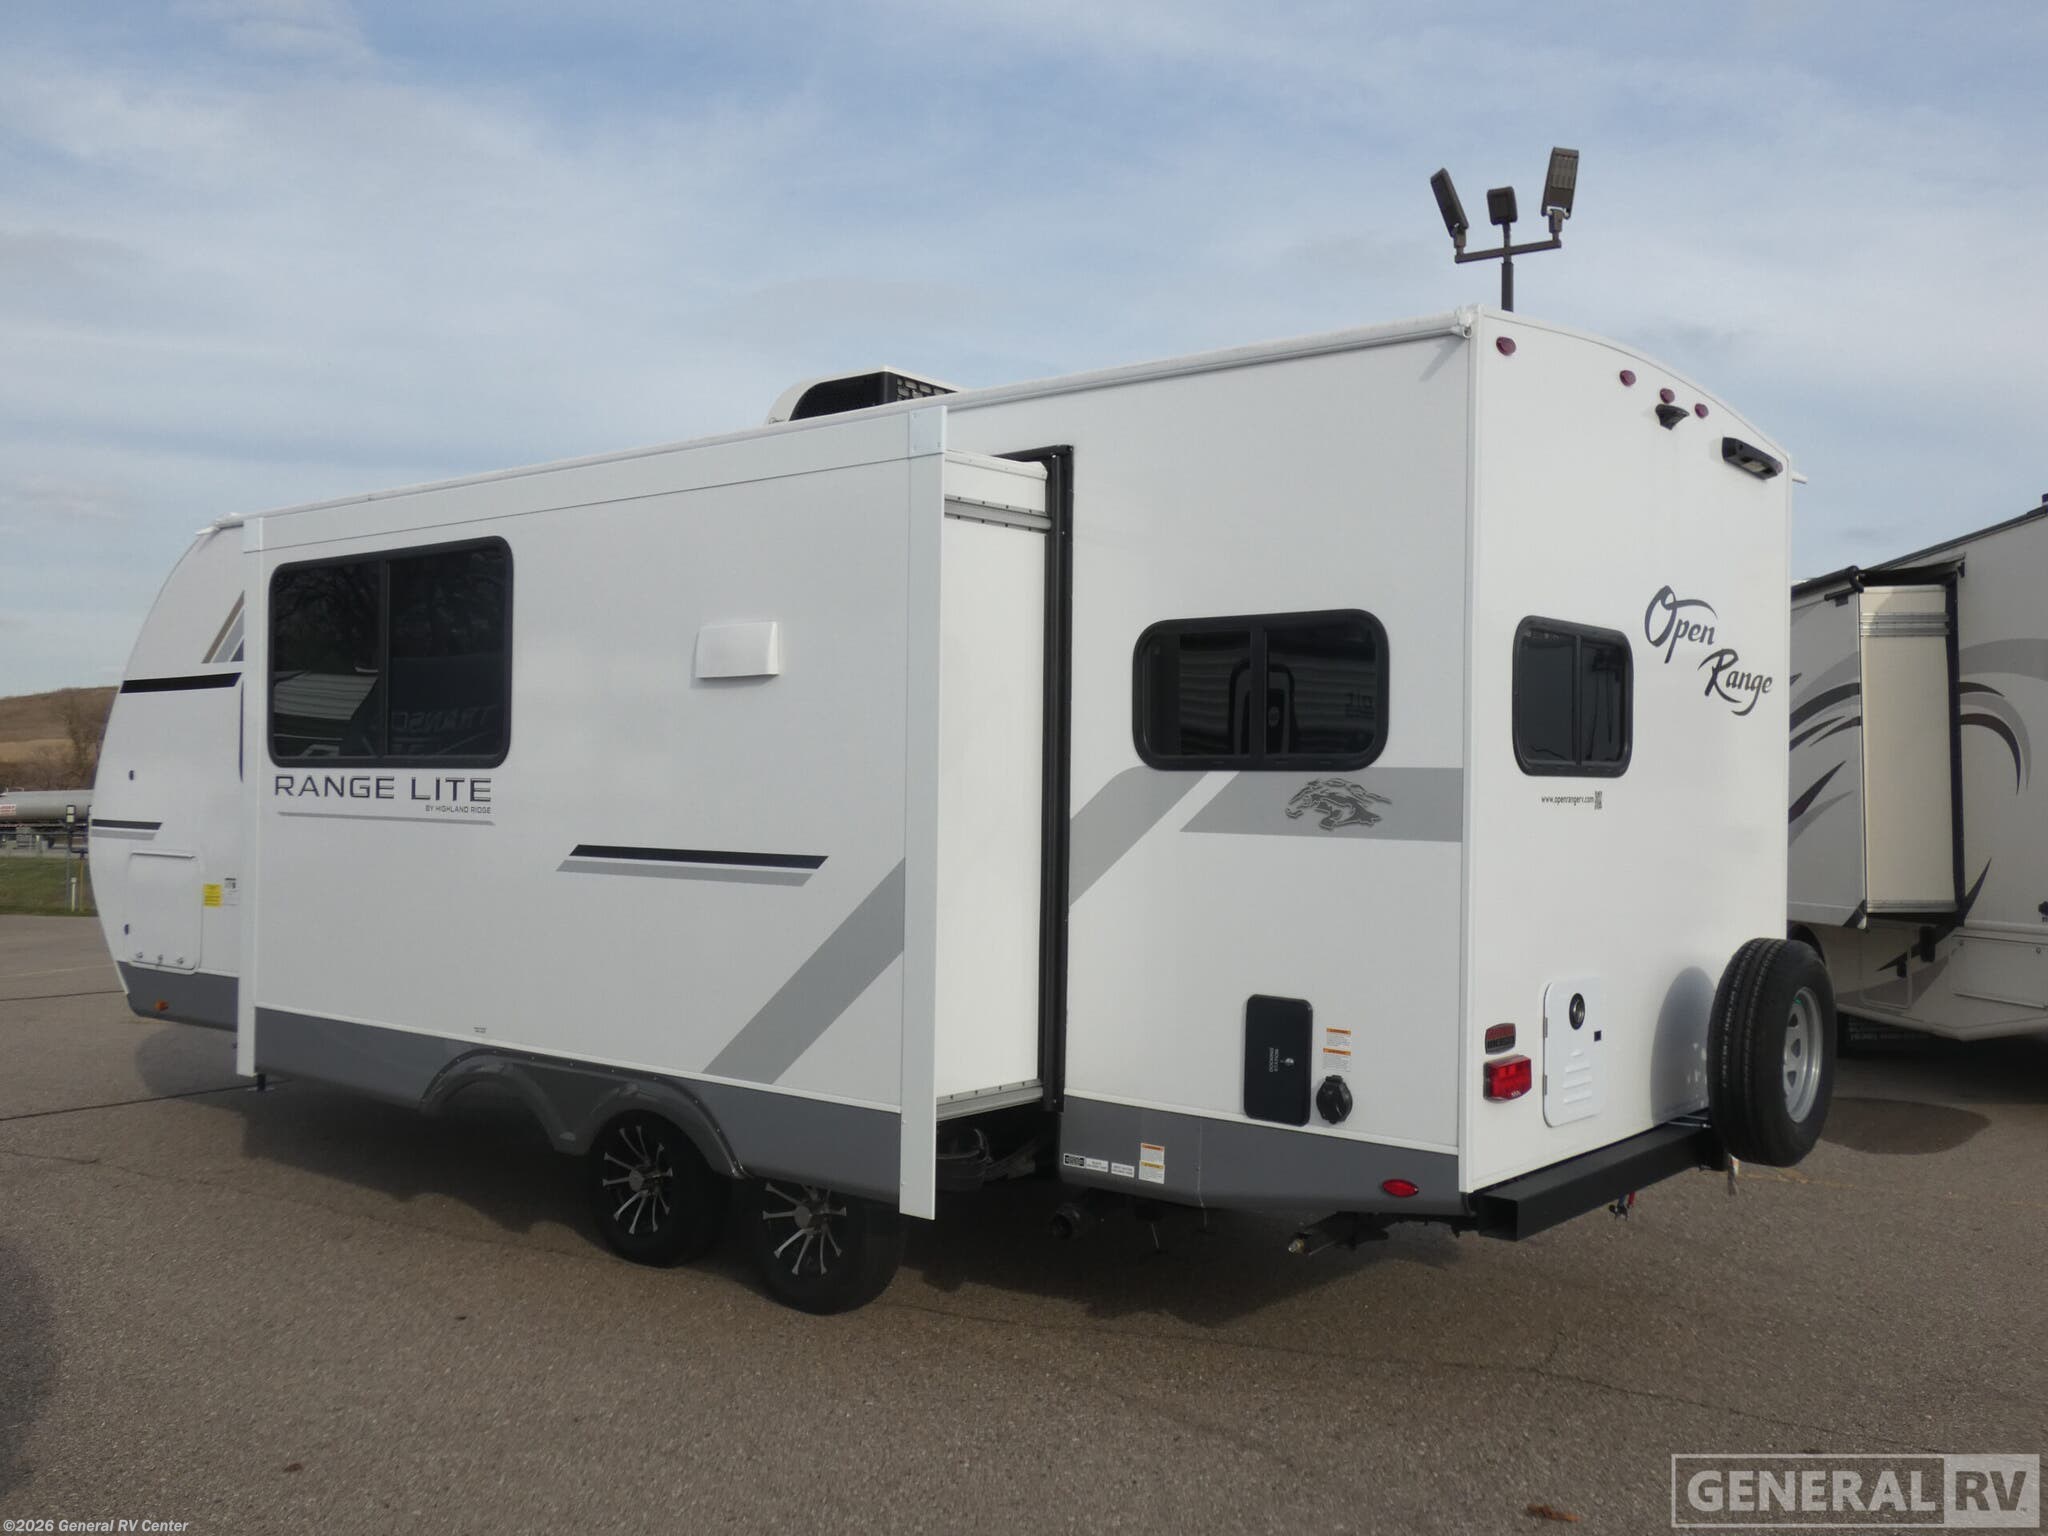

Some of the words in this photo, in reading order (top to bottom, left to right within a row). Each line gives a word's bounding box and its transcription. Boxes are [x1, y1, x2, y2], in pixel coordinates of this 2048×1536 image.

[1644, 585, 1718, 664] Open
[1697, 648, 1773, 716] Range
[274, 775, 395, 799] RANGE
[411, 776, 491, 802] LITE
[425, 804, 434, 812] BY
[435, 805, 469, 813] HIGHLAND
[470, 806, 491, 814] RIDGE
